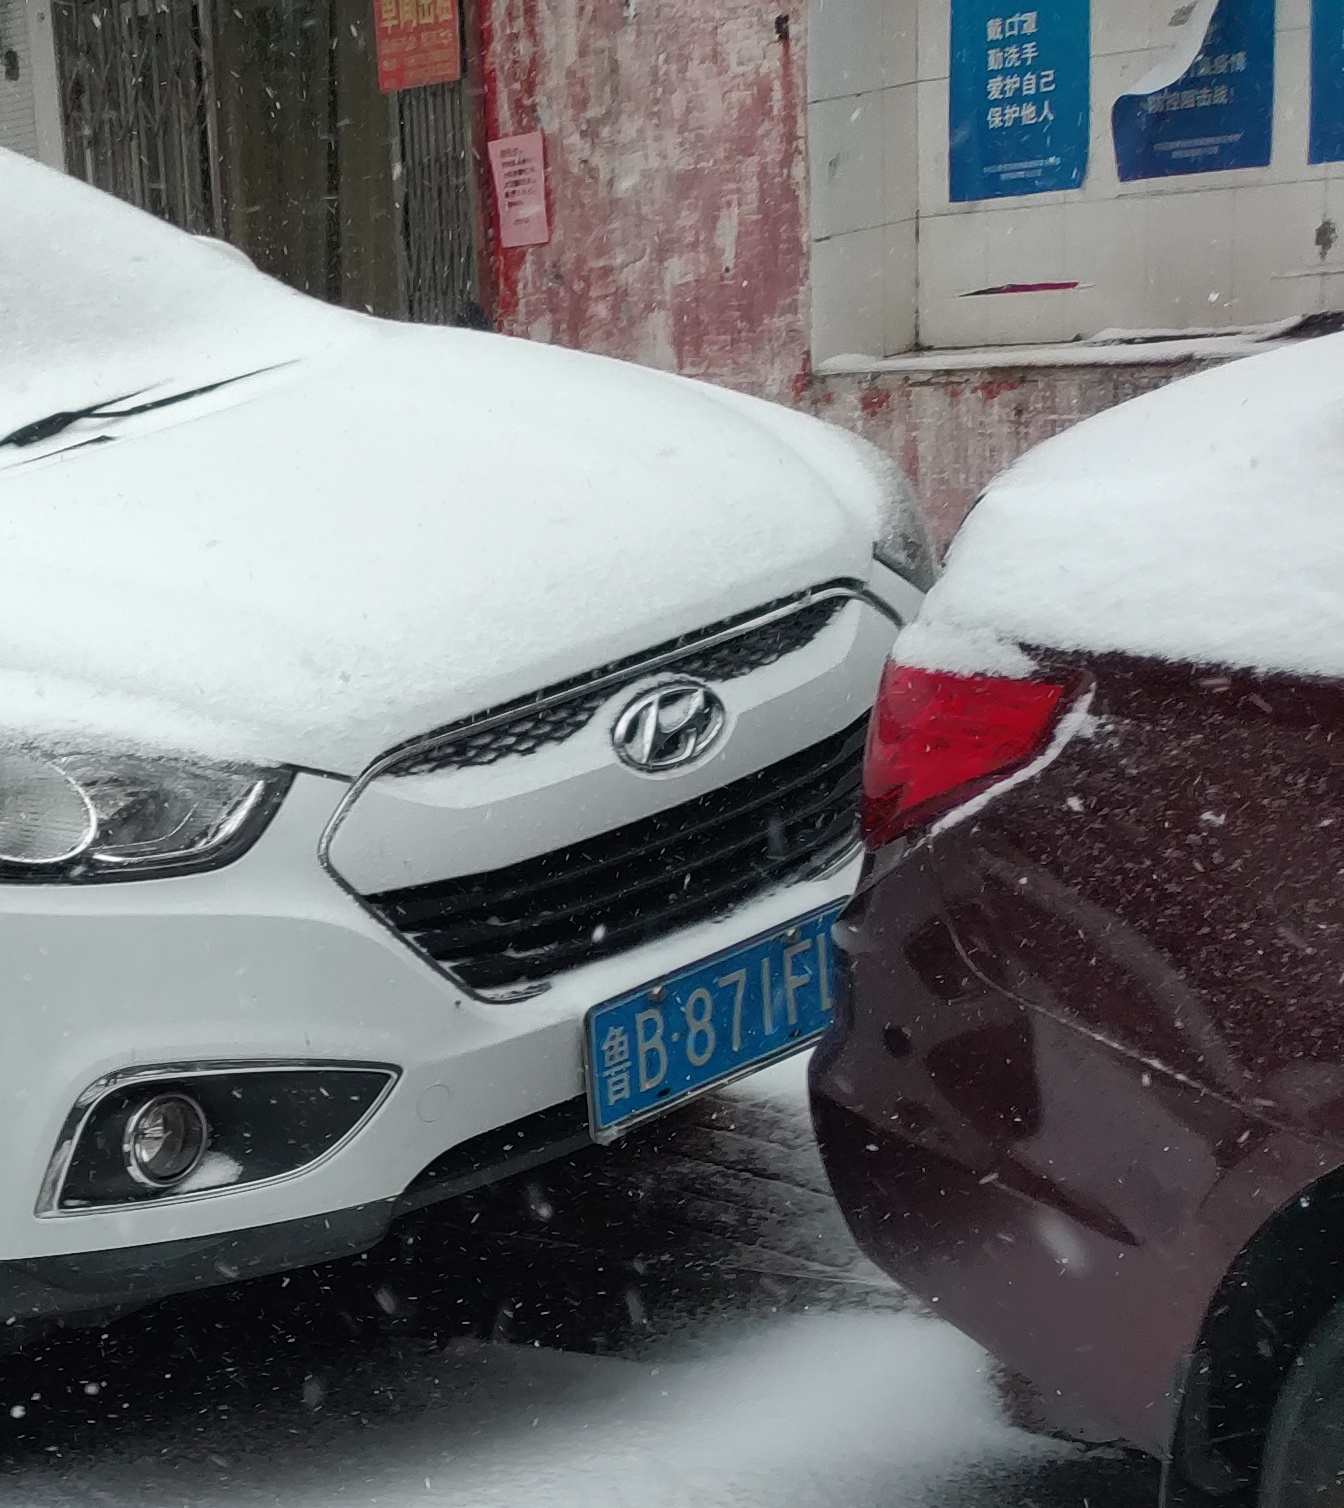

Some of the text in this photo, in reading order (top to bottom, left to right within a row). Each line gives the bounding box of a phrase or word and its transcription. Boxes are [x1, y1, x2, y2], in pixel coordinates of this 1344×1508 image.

[987, 11, 1038, 42] 戴口罩
[987, 42, 1039, 71] 勤洗手
[987, 70, 1055, 100] 爱护自己
[987, 100, 1054, 130] 保护他人
